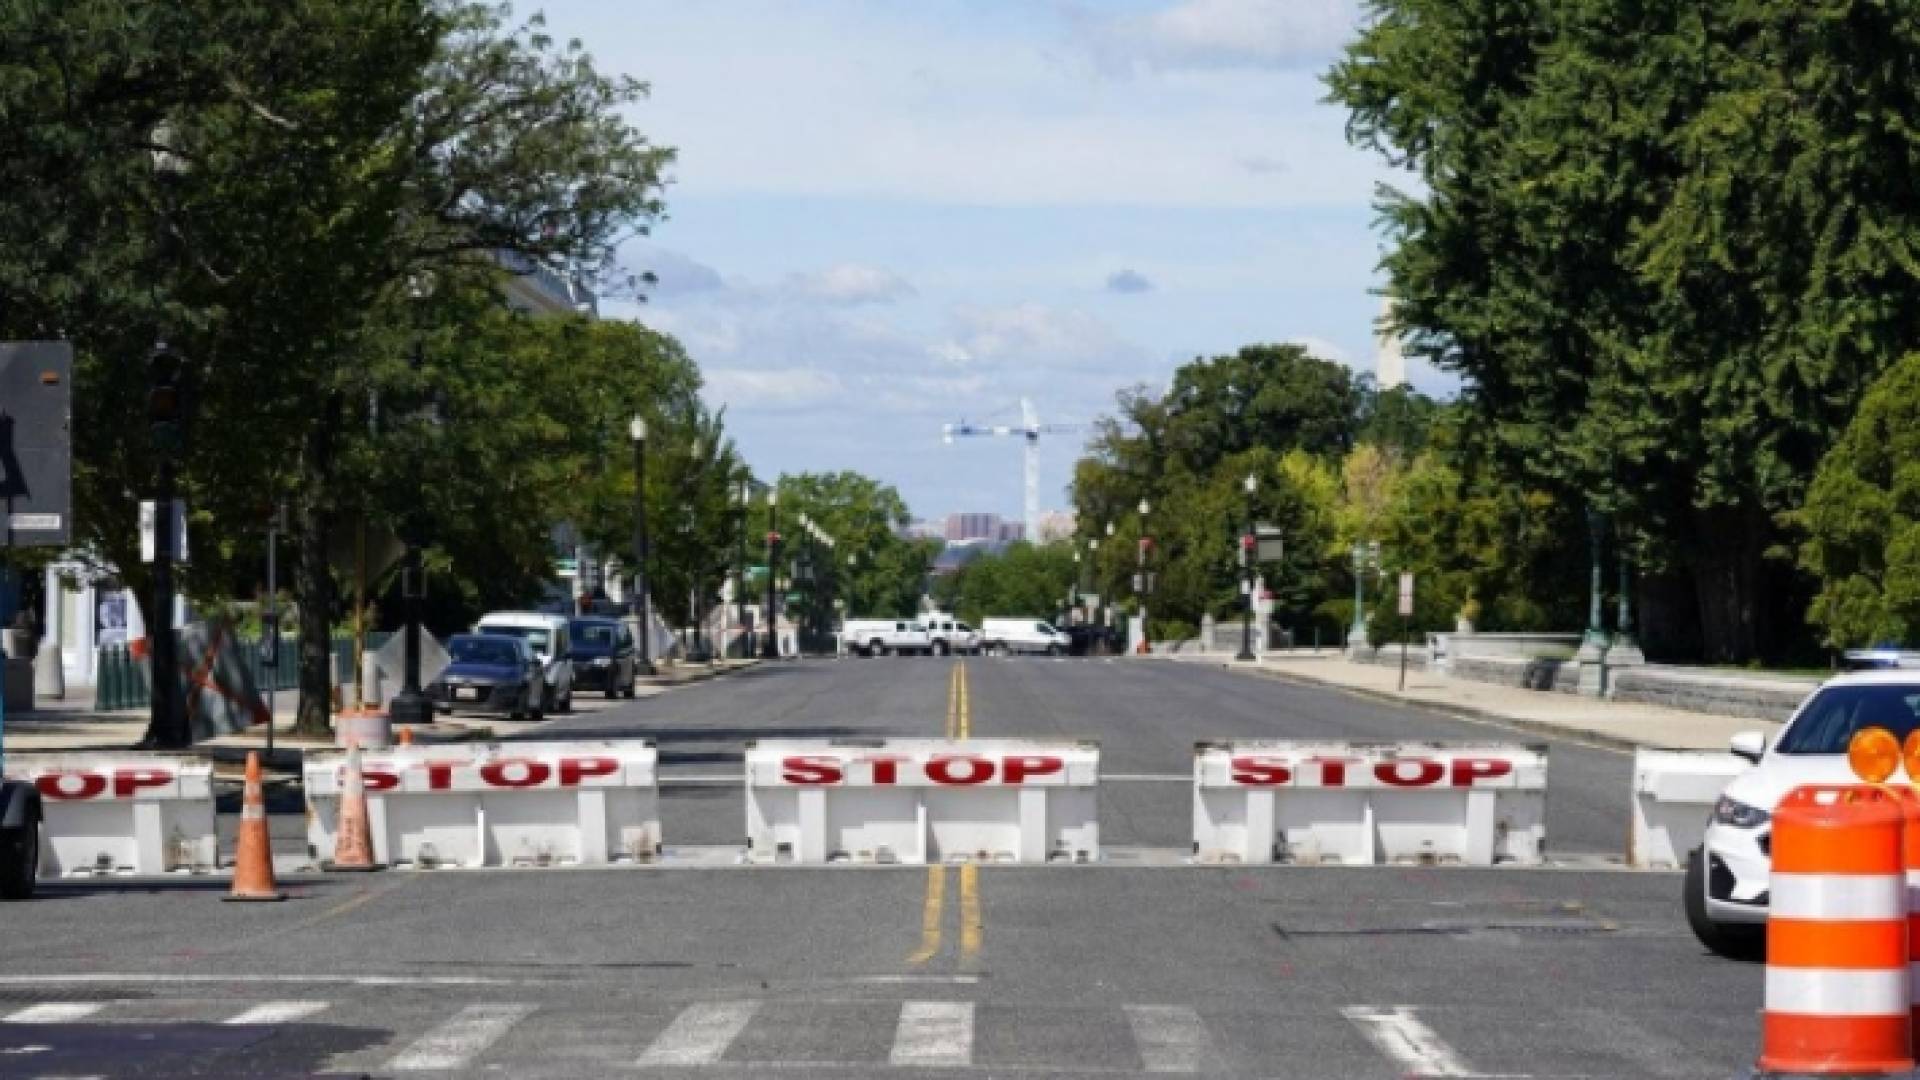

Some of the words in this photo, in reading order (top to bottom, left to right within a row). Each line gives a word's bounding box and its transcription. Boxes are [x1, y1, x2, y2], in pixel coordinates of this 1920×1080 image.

[35, 768, 174, 800] OP
[337, 758, 618, 791] STOP
[782, 755, 1063, 787] STOP
[1231, 756, 1512, 789] STOP
